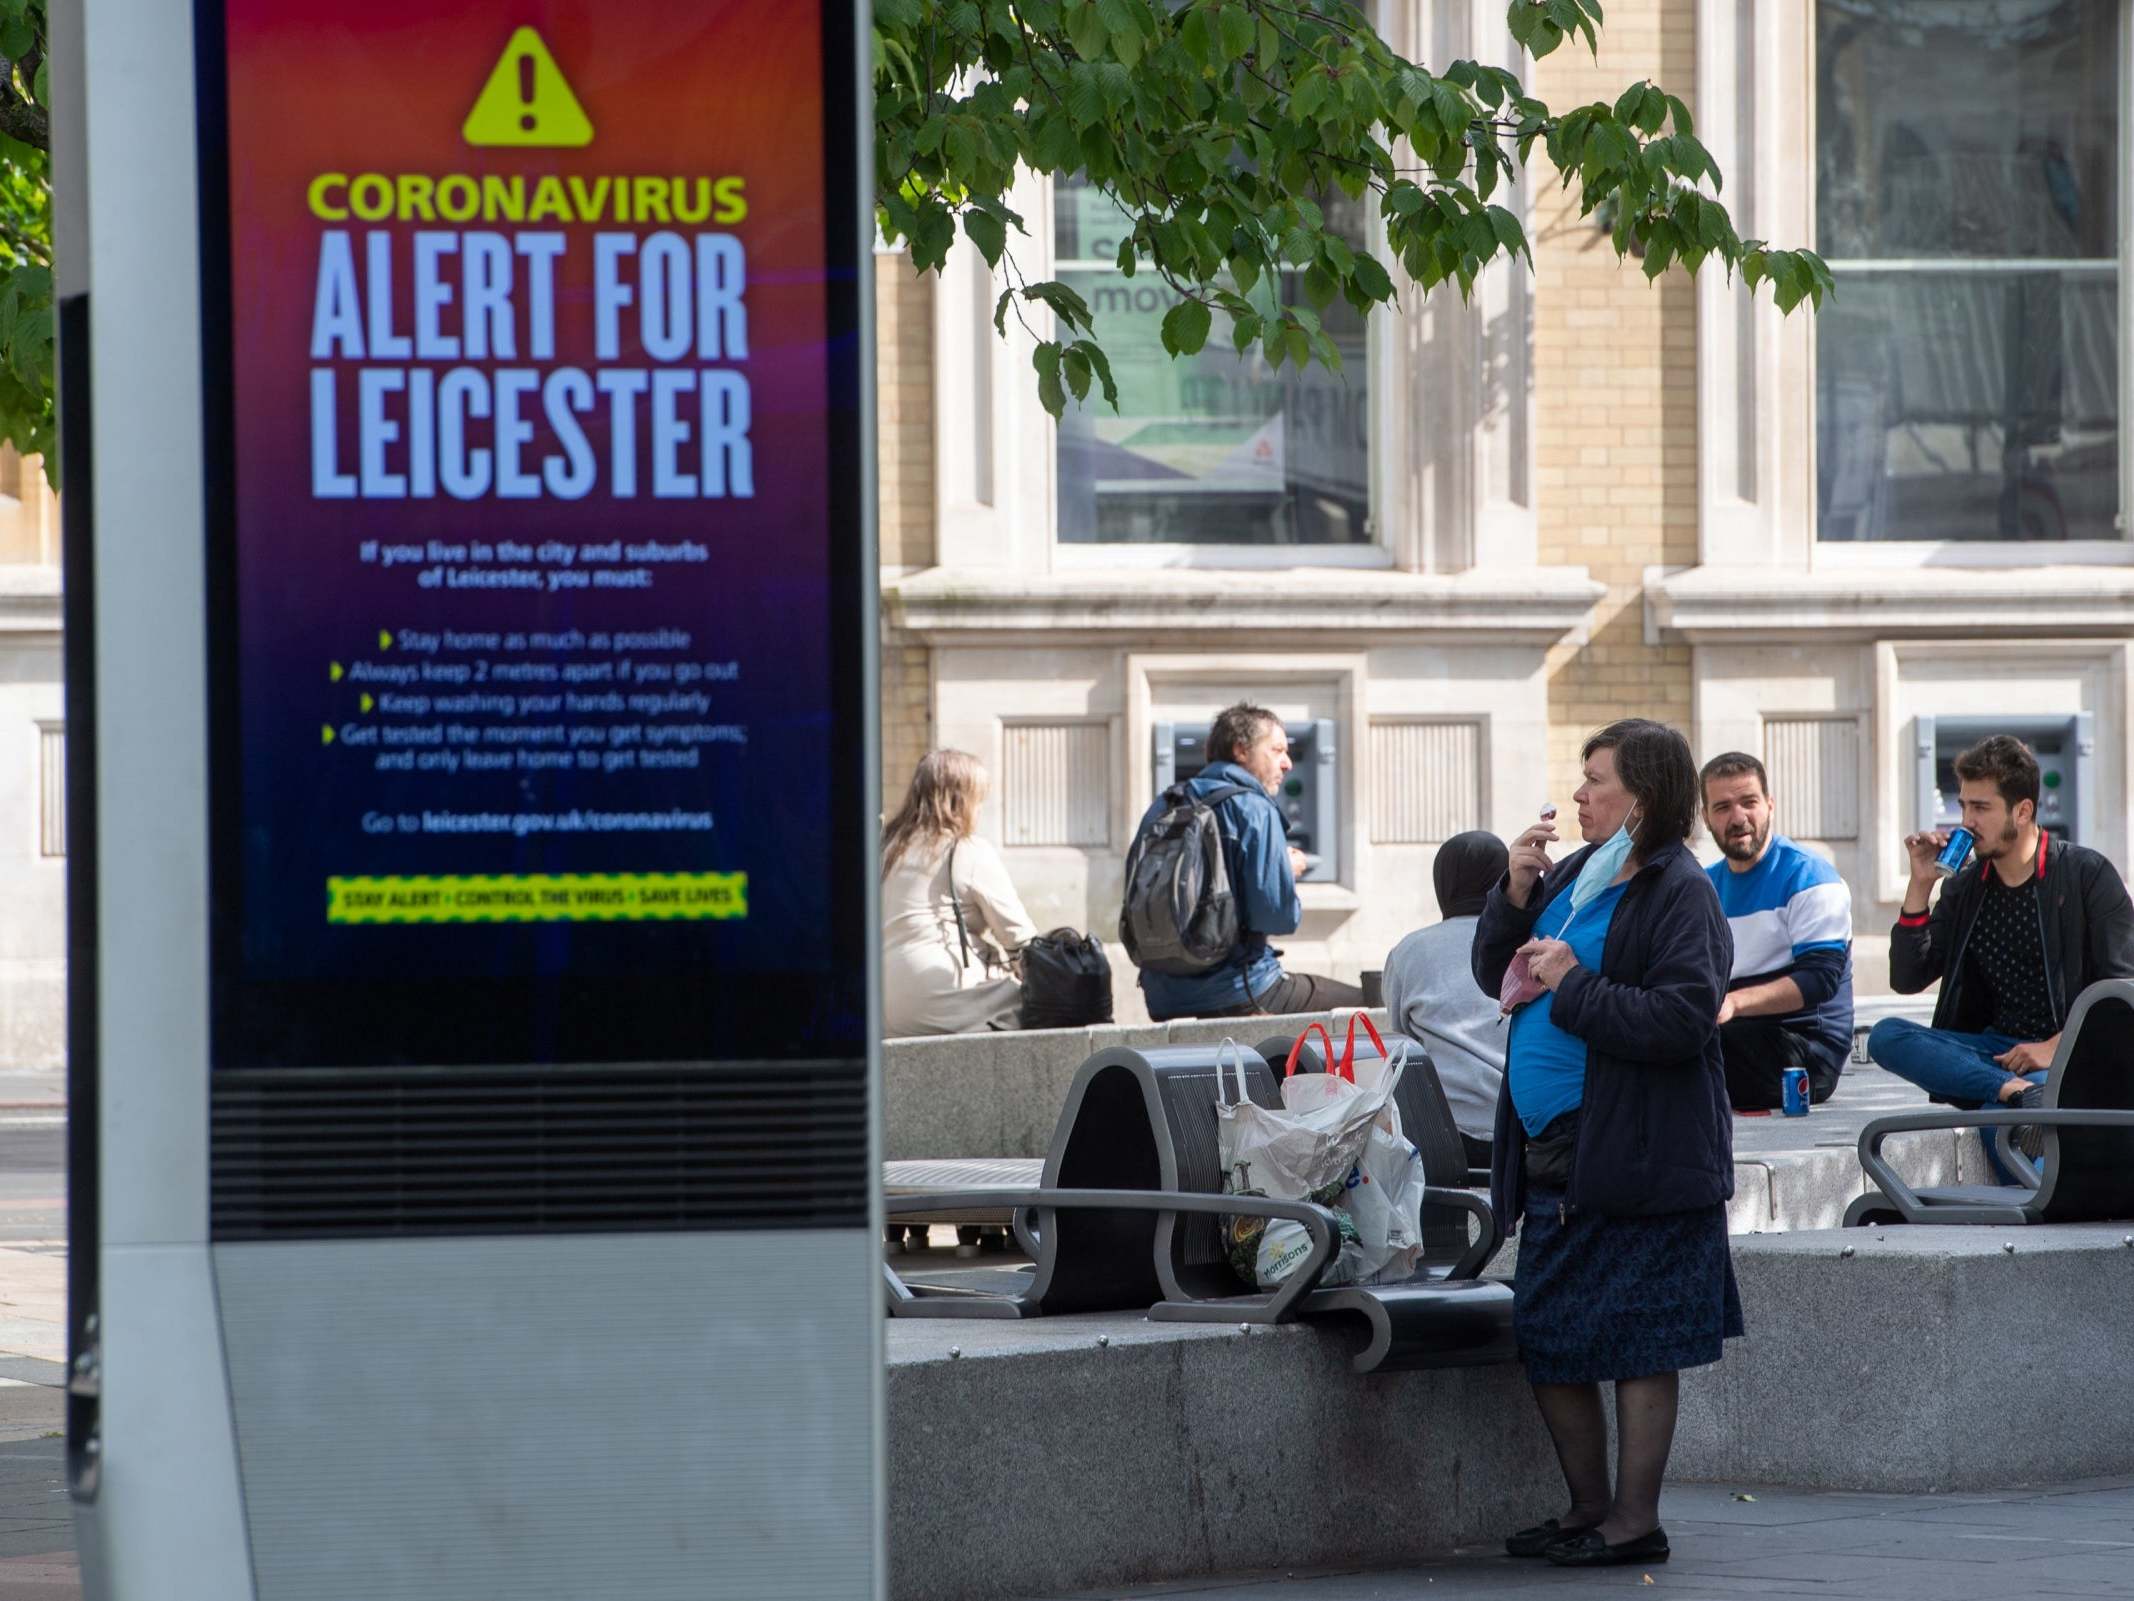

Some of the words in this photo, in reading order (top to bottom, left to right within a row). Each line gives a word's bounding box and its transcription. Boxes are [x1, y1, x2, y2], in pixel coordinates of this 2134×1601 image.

[307, 172, 748, 223] CORONAVIRUS
[310, 230, 566, 360] ALERT
[594, 231, 749, 362] FOR
[310, 366, 754, 500] LEICESTER
[360, 540, 378, 562] If
[382, 545, 424, 567] you
[427, 540, 467, 562] live
[470, 540, 493, 562] in
[497, 540, 534, 562] the
[536, 540, 577, 566] city
[579, 540, 622, 562] and
[625, 540, 709, 562] suburbs
[417, 566, 444, 588] of
[447, 567, 544, 590] Leicester,
[547, 571, 590, 592] you
[593, 569, 653, 588] must:
[398, 629, 440, 654] Stay
[443, 629, 499, 649] home
[503, 633, 527, 649] as
[529, 629, 586, 649] much
[588, 633, 611, 648] as
[613, 628, 692, 653] possible
[349, 661, 420, 685] Always
[422, 660, 472, 684] keep
[474, 660, 488, 682] 2
[492, 663, 559, 682] metres
[562, 661, 613, 684] apart
[617, 659, 631, 681] if
[634, 664, 672, 685] you
[674, 663, 702, 684] go
[703, 662, 738, 681] out
[379, 693, 432, 716] Keep
[433, 692, 515, 716] washing
[518, 695, 562, 716] your
[565, 691, 626, 713] hands
[627, 690, 712, 716] regularly
[341, 723, 378, 746] Get
[382, 724, 443, 744] tested
[447, 723, 480, 743] the
[483, 725, 564, 744] moment
[567, 726, 606, 746] you
[608, 725, 642, 747] get
[375, 749, 415, 770] and
[417, 749, 460, 774] only
[463, 749, 514, 770] leave
[517, 748, 574, 769] home
[577, 750, 600, 768] to
[602, 750, 636, 774] get
[639, 747, 699, 768] tested
[361, 811, 394, 833] Go
[397, 813, 420, 832] to
[343, 891, 384, 908] STAY
[387, 890, 441, 907] ALERT
[455, 890, 535, 907] CONTROL
[539, 889, 570, 906] THE
[574, 888, 625, 905] VIRUS
[639, 887, 682, 904] SAVE
[685, 887, 732, 904] LIVES
[1263, 1243, 1308, 1280] Morrisons
